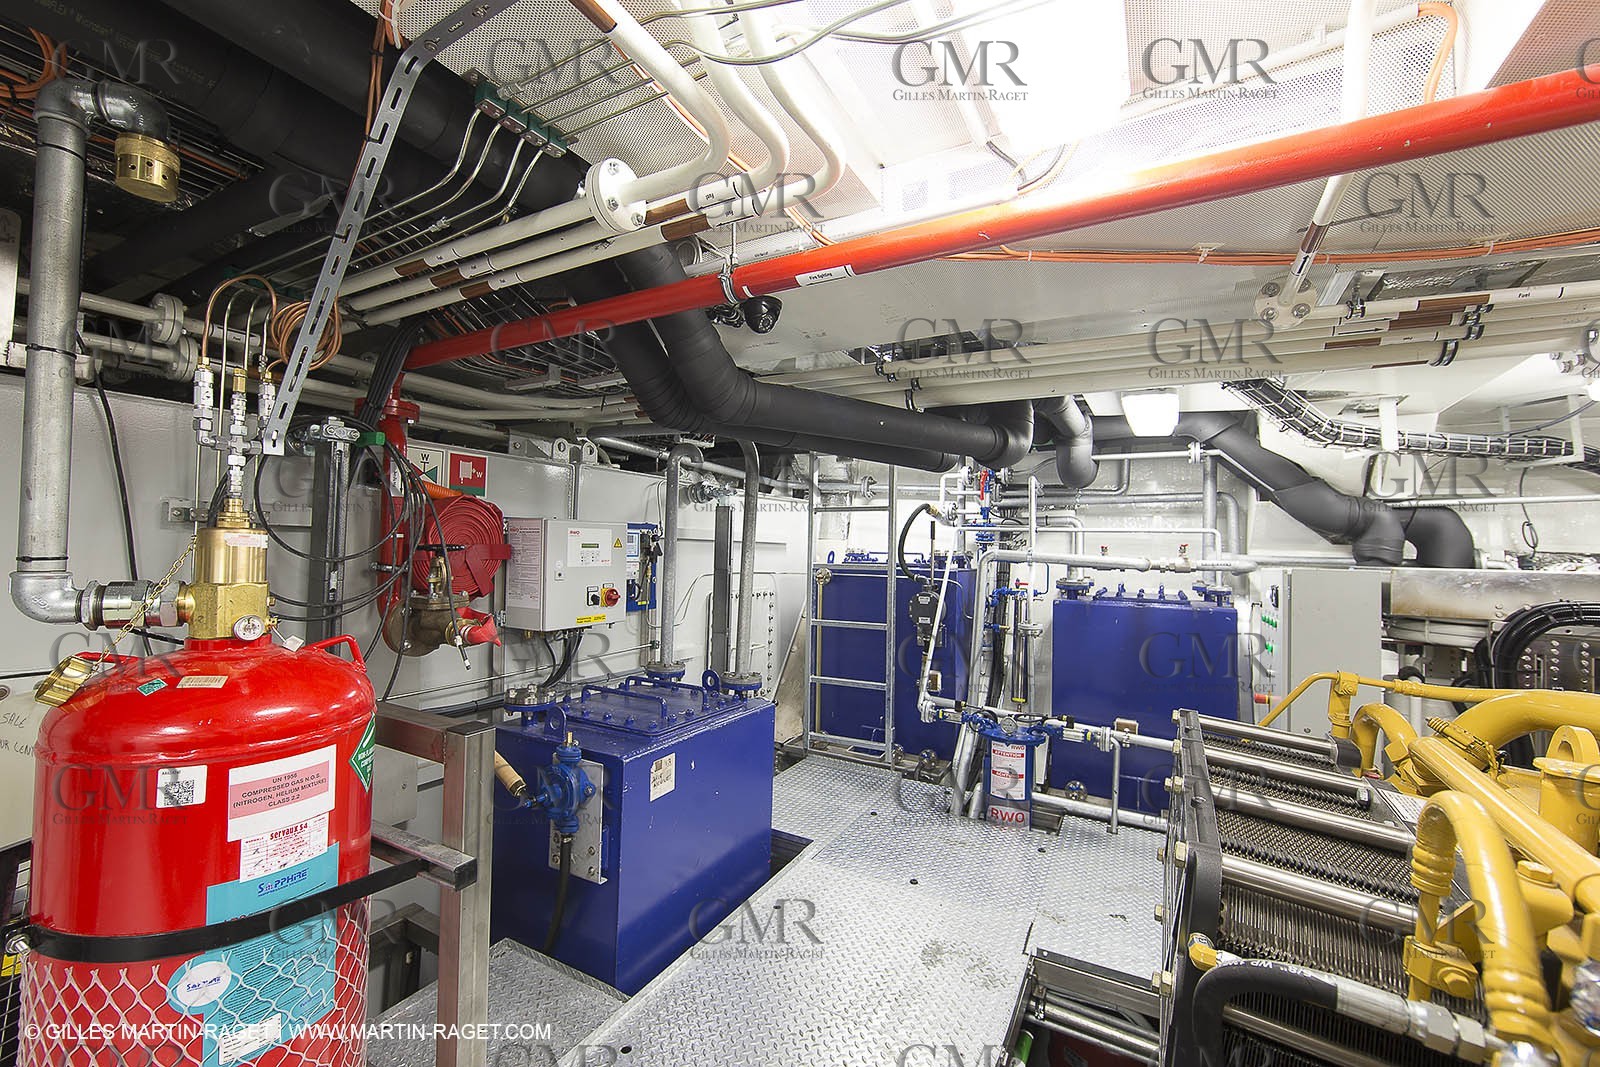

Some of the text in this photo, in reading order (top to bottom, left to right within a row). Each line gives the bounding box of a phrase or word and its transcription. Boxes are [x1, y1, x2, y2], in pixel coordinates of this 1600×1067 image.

[242, 782, 290, 798] COMPRESSED
[290, 776, 304, 786] GAS
[276, 786, 300, 798] HELIUM
[268, 797, 290, 808] CLASS
[991, 806, 1025, 823] RWO
